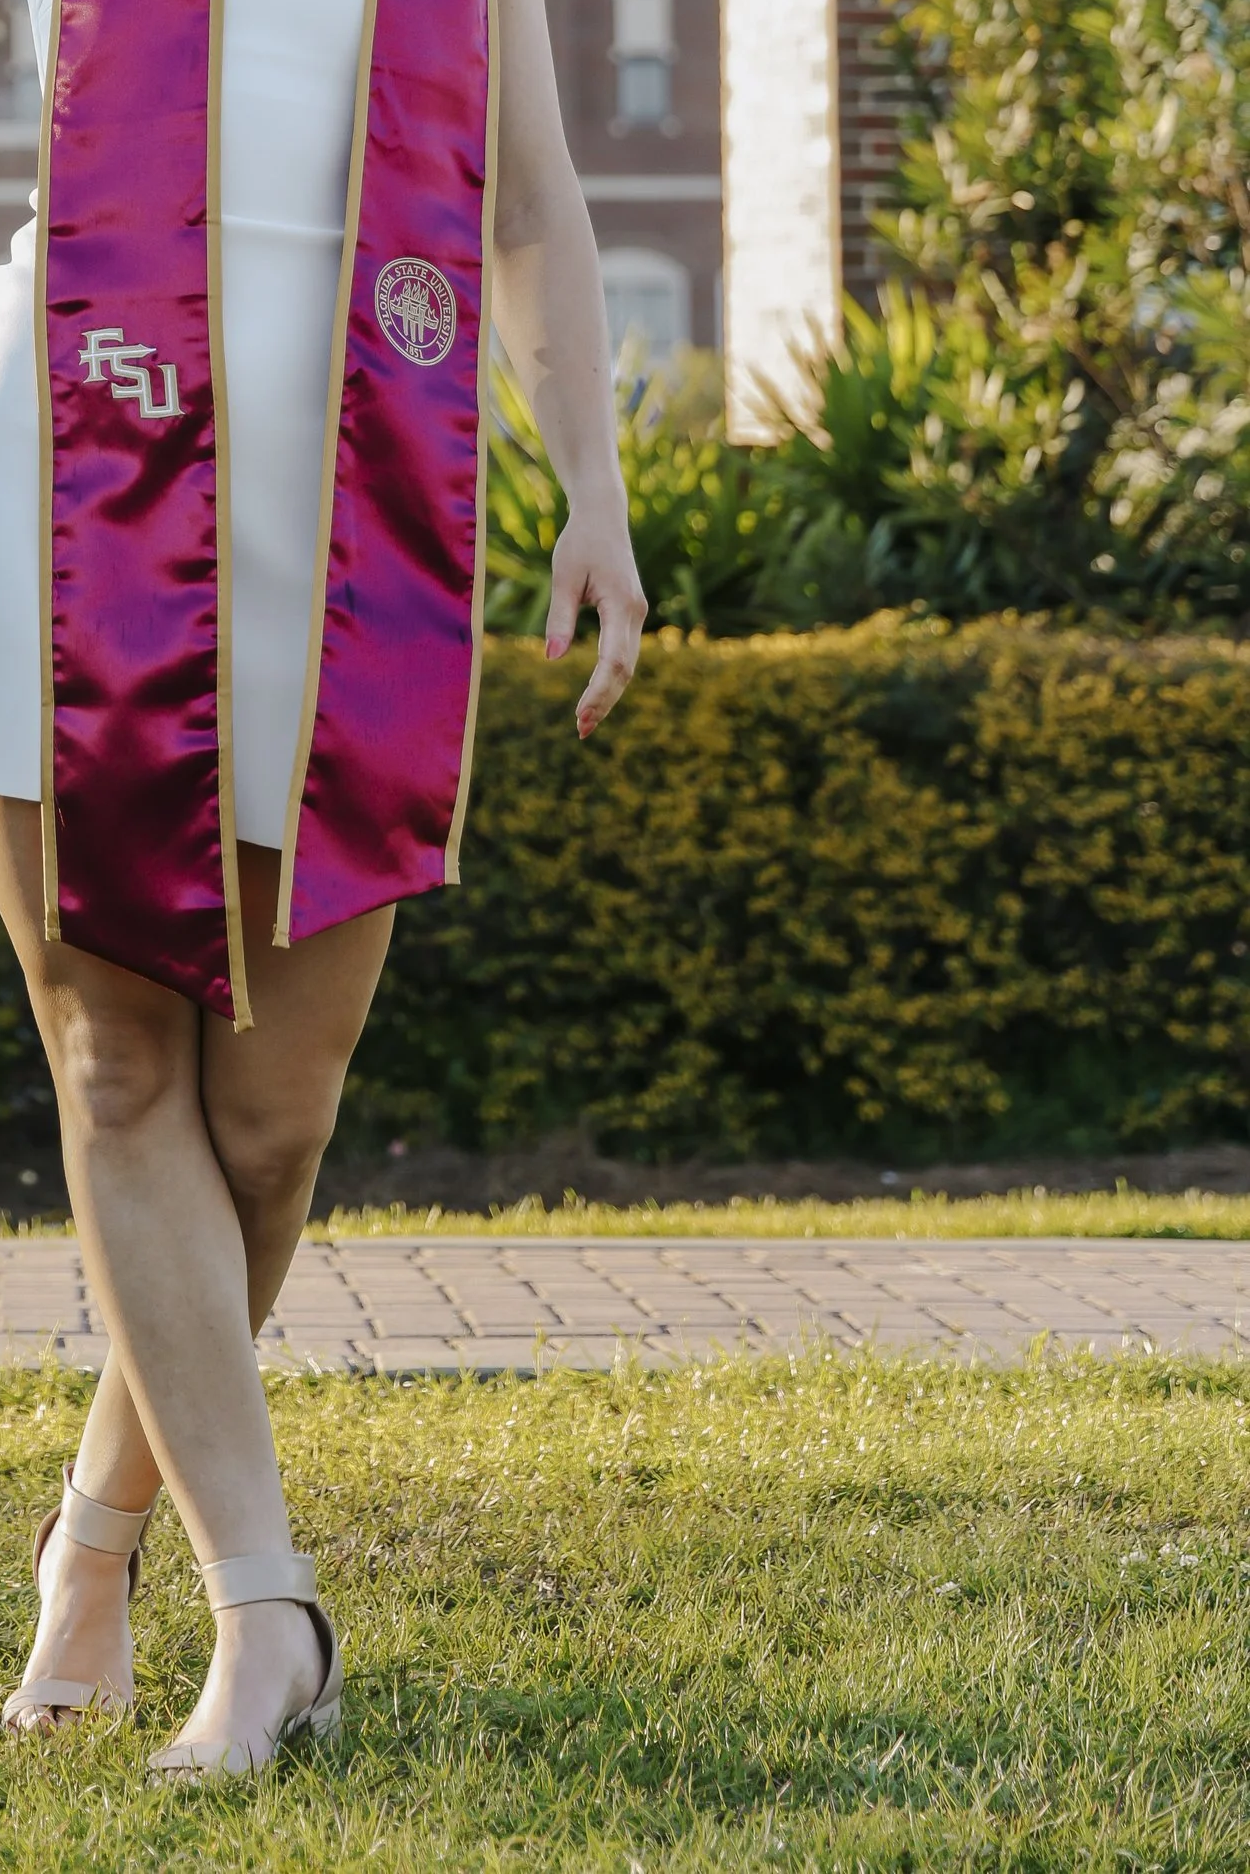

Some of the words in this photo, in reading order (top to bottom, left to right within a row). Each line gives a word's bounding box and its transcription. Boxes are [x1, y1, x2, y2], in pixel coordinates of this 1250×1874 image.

[379, 274, 396, 327] FLORIDA
[394, 265, 428, 279] STATE
[430, 275, 451, 351] UNIVERSITY
[405, 343, 424, 359] 1851
[78, 327, 185, 418] FSU
